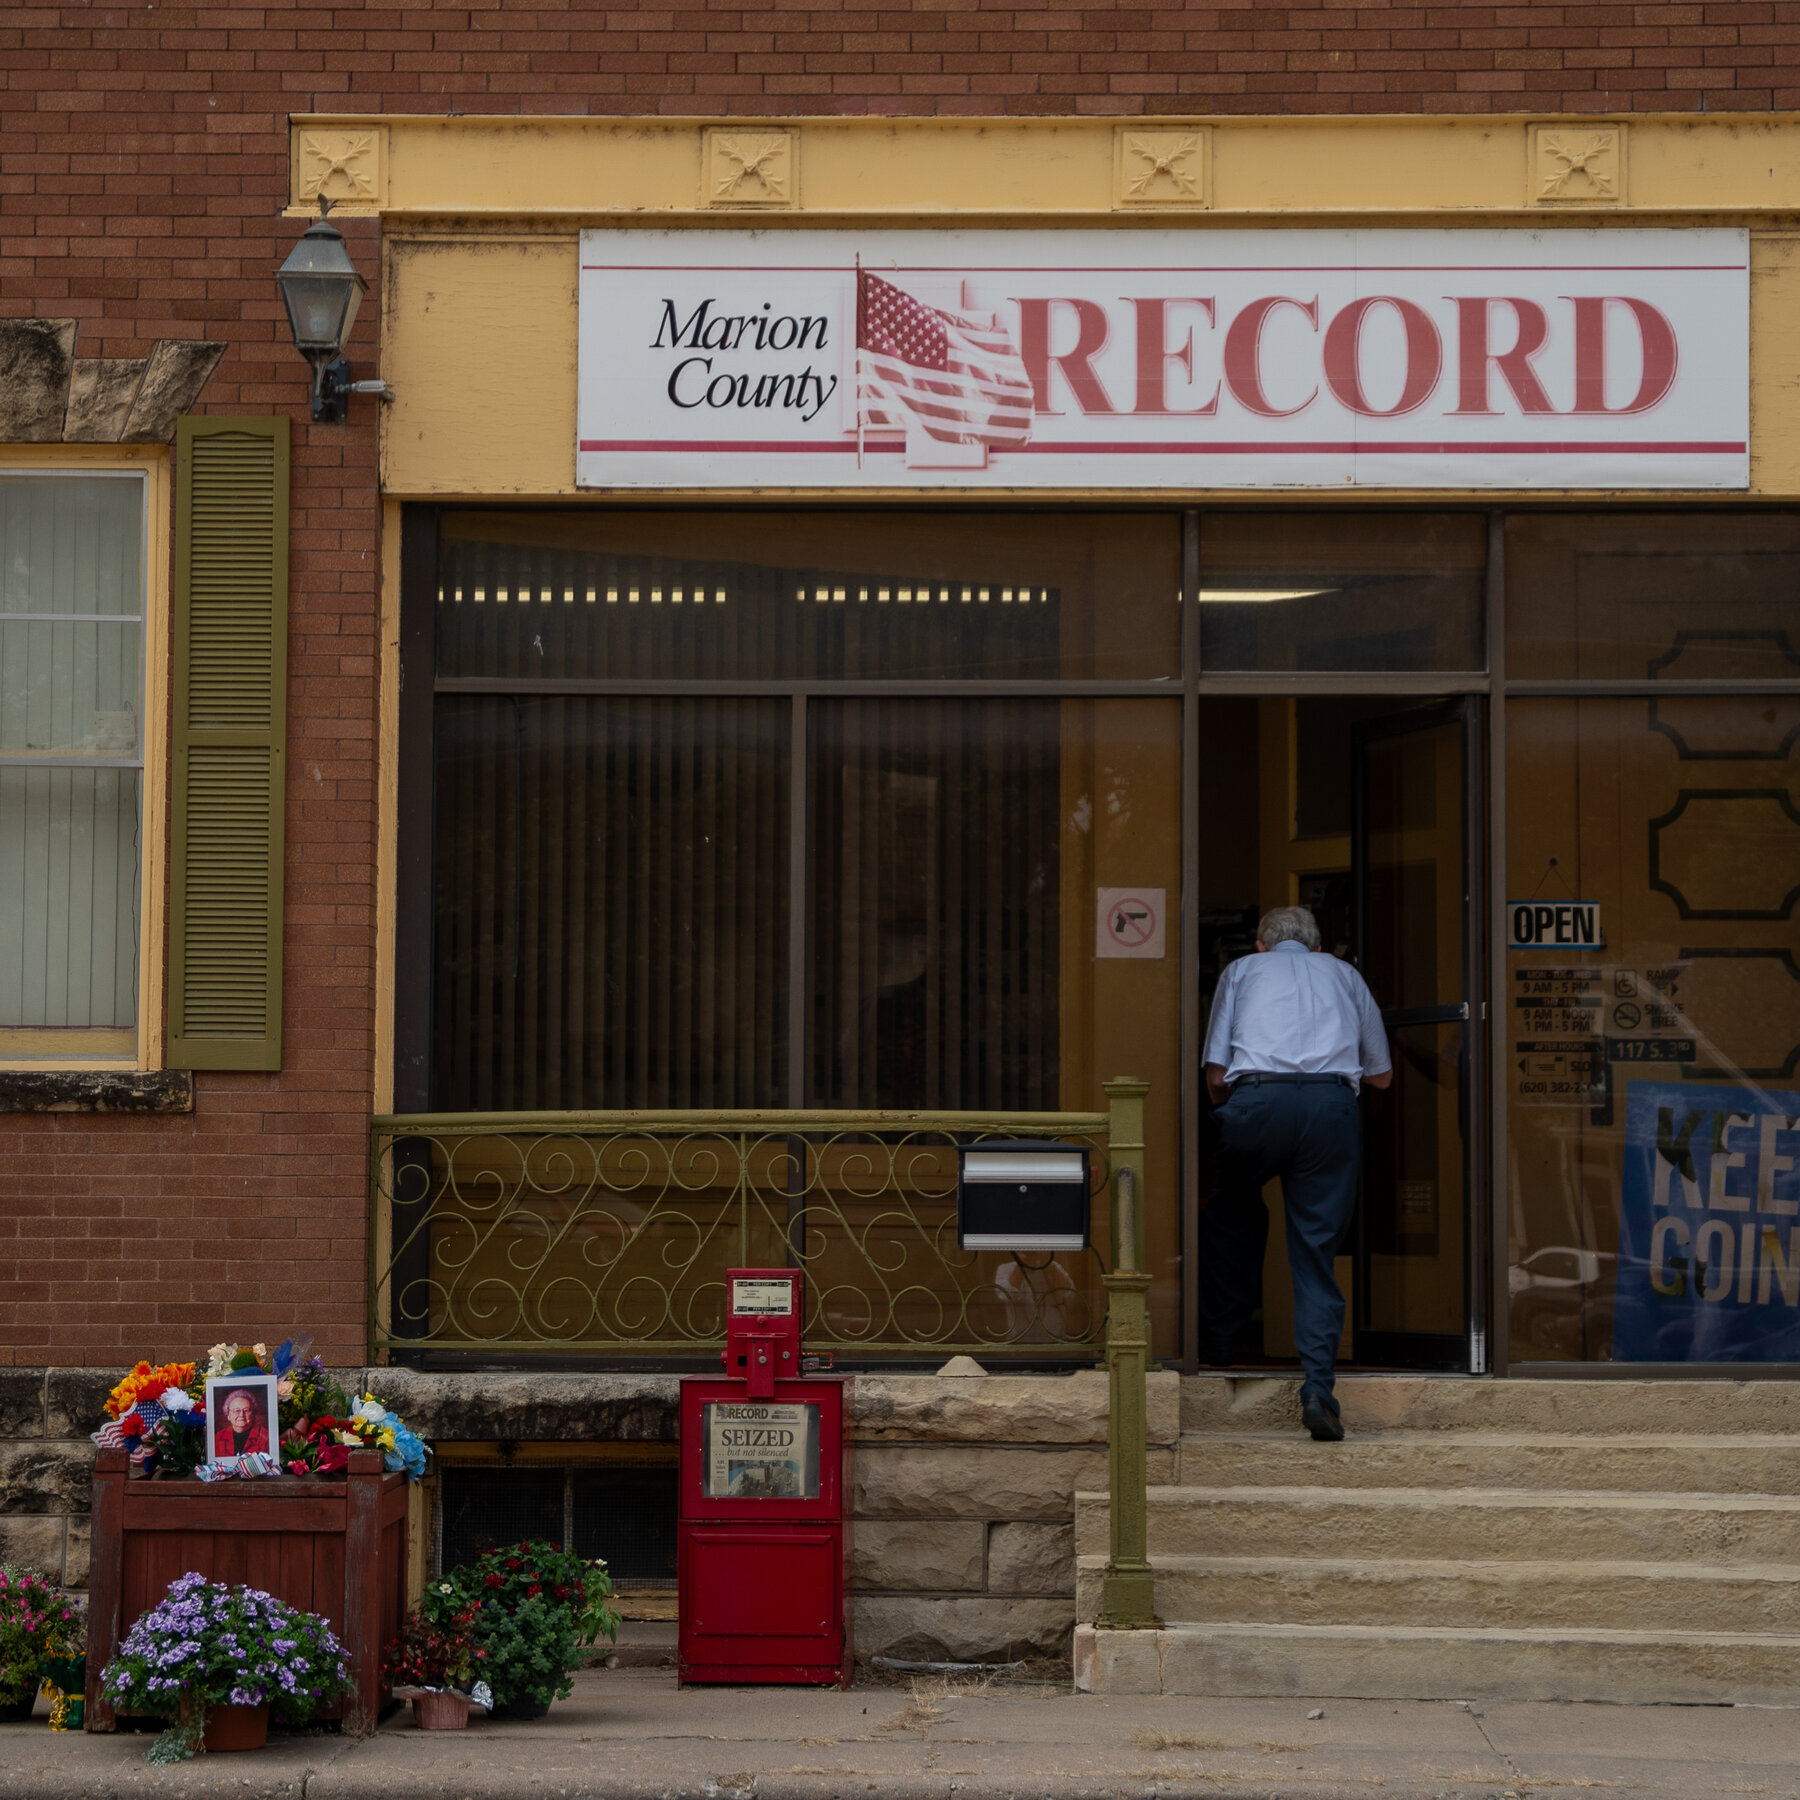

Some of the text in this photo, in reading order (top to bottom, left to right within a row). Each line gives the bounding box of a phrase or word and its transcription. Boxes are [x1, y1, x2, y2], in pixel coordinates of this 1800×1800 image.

[648, 298, 828, 352] Marion
[1010, 292, 1679, 418] RECORD
[666, 356, 838, 421] County
[1514, 906, 1594, 943] OPEN
[1646, 970, 1680, 980] RAMP
[1523, 982, 1530, 993] 9
[1533, 982, 1552, 993] AM
[1562, 982, 1568, 993] 5
[1572, 982, 1590, 993] PM
[1523, 1009, 1530, 1020] 9
[1534, 1009, 1552, 1020] AM
[1562, 1009, 1595, 1020] NOON
[1644, 1003, 1684, 1015] SMOKE
[1525, 1021, 1530, 1032] 1
[1535, 1021, 1552, 1032] PM
[1562, 1021, 1568, 1032] 5
[1572, 1021, 1590, 1032] PM
[1651, 1016, 1677, 1026] FREE
[1616, 1042, 1645, 1058] 117
[1649, 1042, 1664, 1058] S.
[1520, 1081, 1547, 1094] (620)
[728, 1407, 769, 1420] RECORD
[721, 1429, 794, 1446] SEIZED
[727, 1447, 741, 1456] but
[743, 1447, 756, 1456] not
[758, 1447, 789, 1456] silenced
